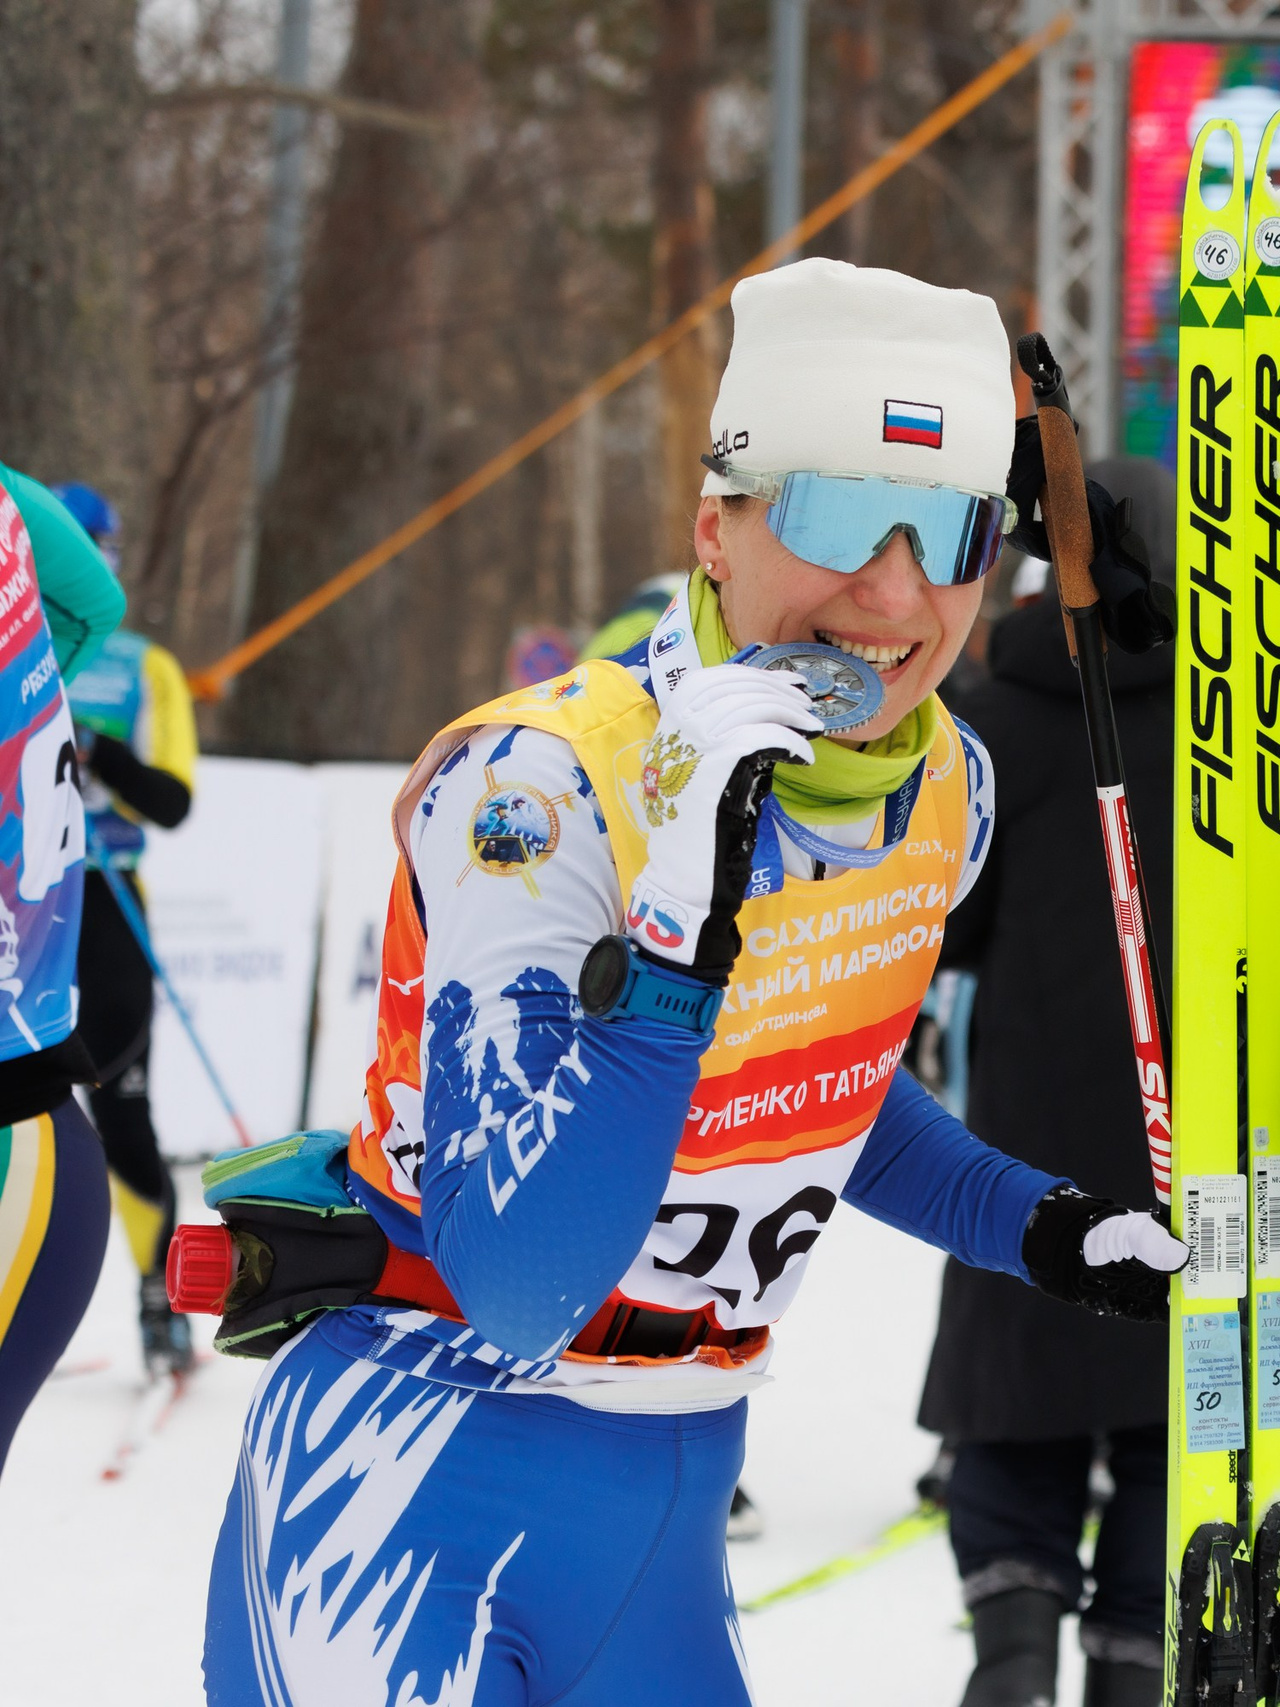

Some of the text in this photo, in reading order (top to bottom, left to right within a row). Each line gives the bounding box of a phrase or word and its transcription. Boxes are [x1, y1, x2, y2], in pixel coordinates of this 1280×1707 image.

[1204, 244, 1229, 265] 46
[1189, 363, 1235, 860] FISCHER
[746, 882, 947, 958] САХАЛИНСКИ
[1188, 1340, 1211, 1350] XVII
[1194, 1391, 1221, 1411] 50
